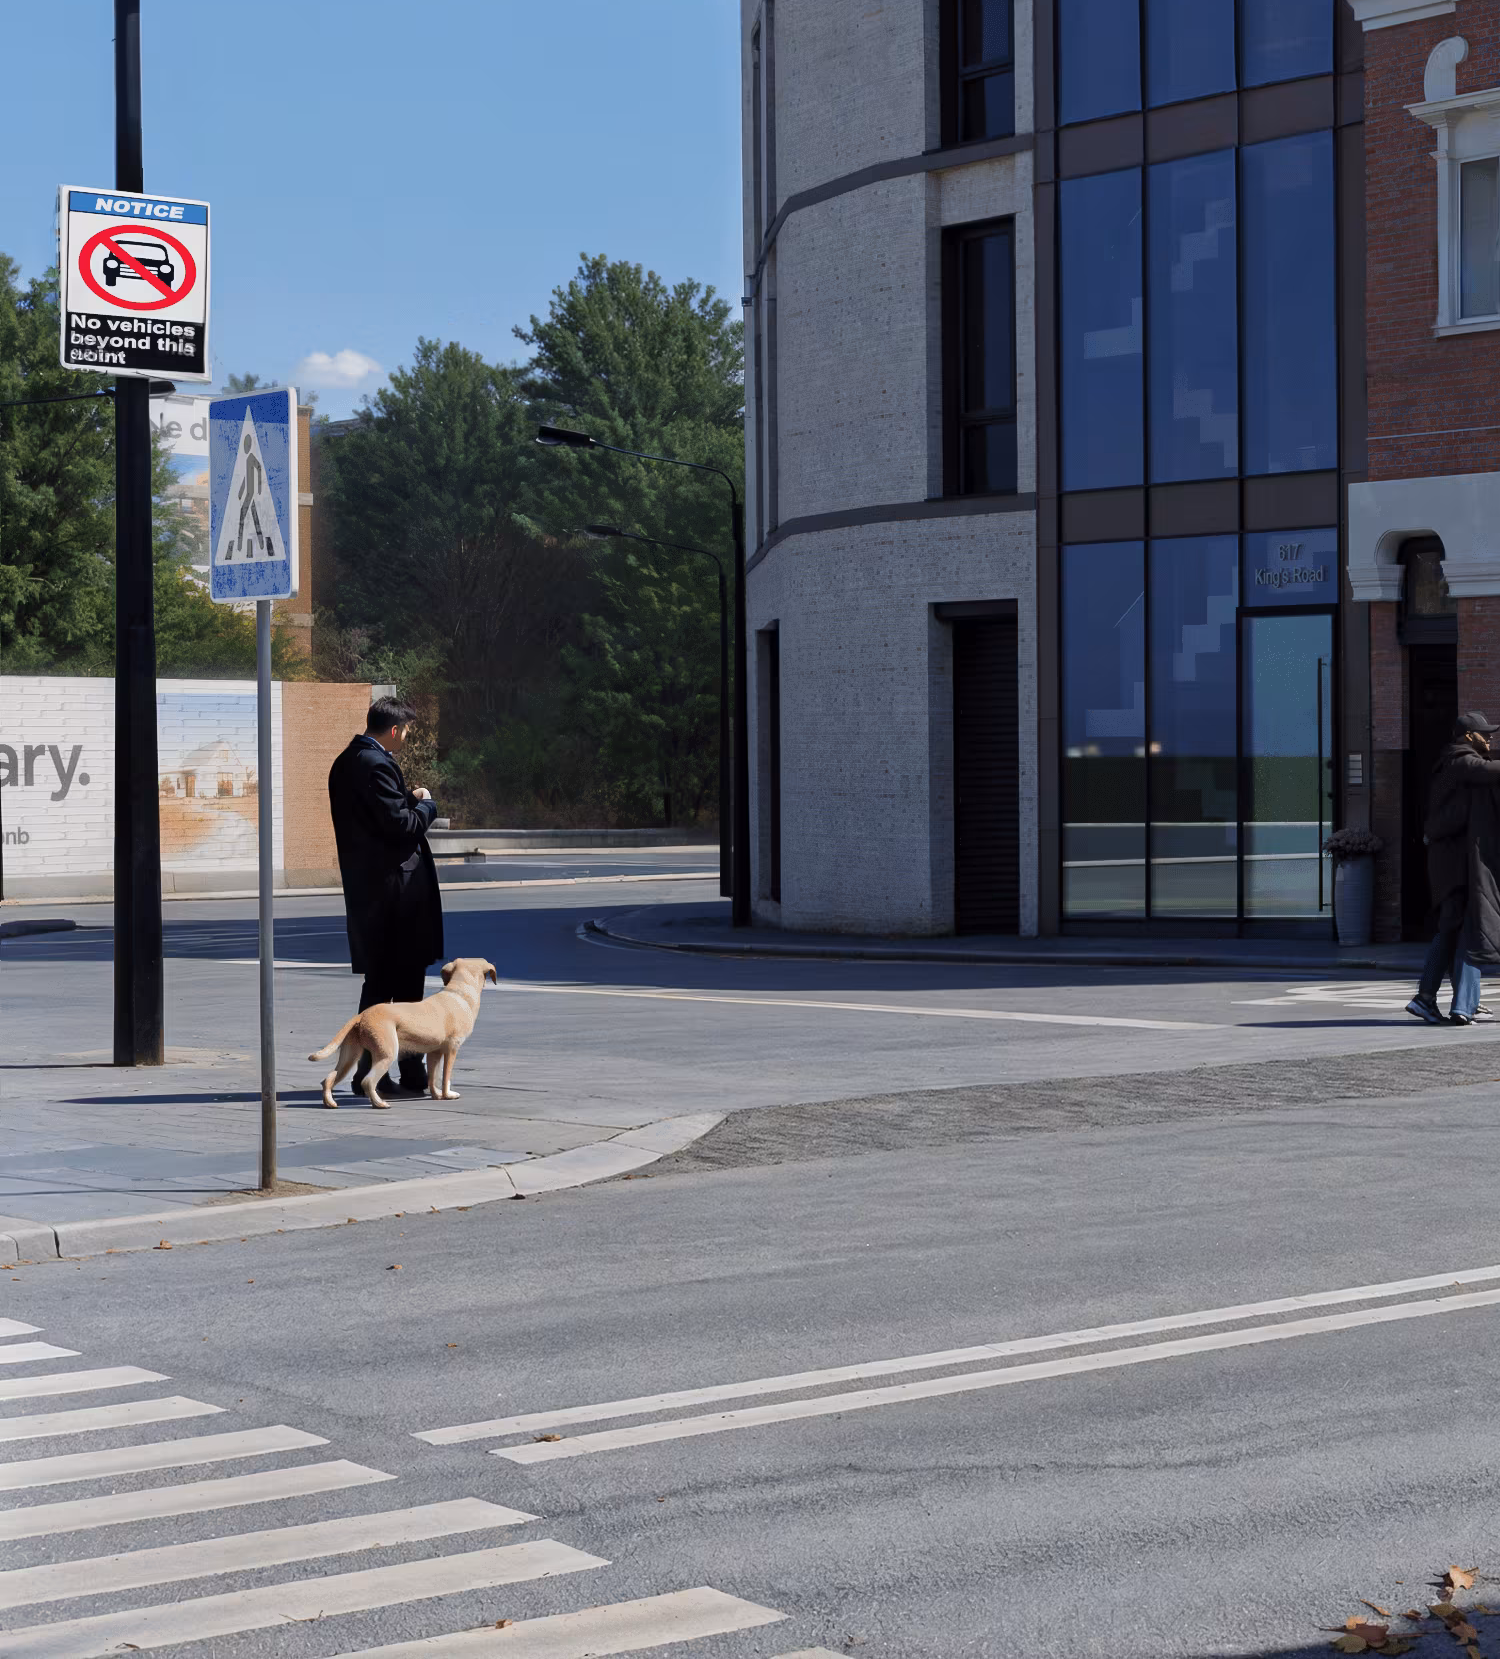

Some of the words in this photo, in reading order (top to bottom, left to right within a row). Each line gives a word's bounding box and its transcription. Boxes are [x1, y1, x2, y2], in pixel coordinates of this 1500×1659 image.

[95, 197, 185, 219] NOTICE
[70, 313, 101, 329] No
[107, 319, 196, 337] vehicles
[70, 330, 151, 349] beyond
[1293, 564, 1324, 583] Road
